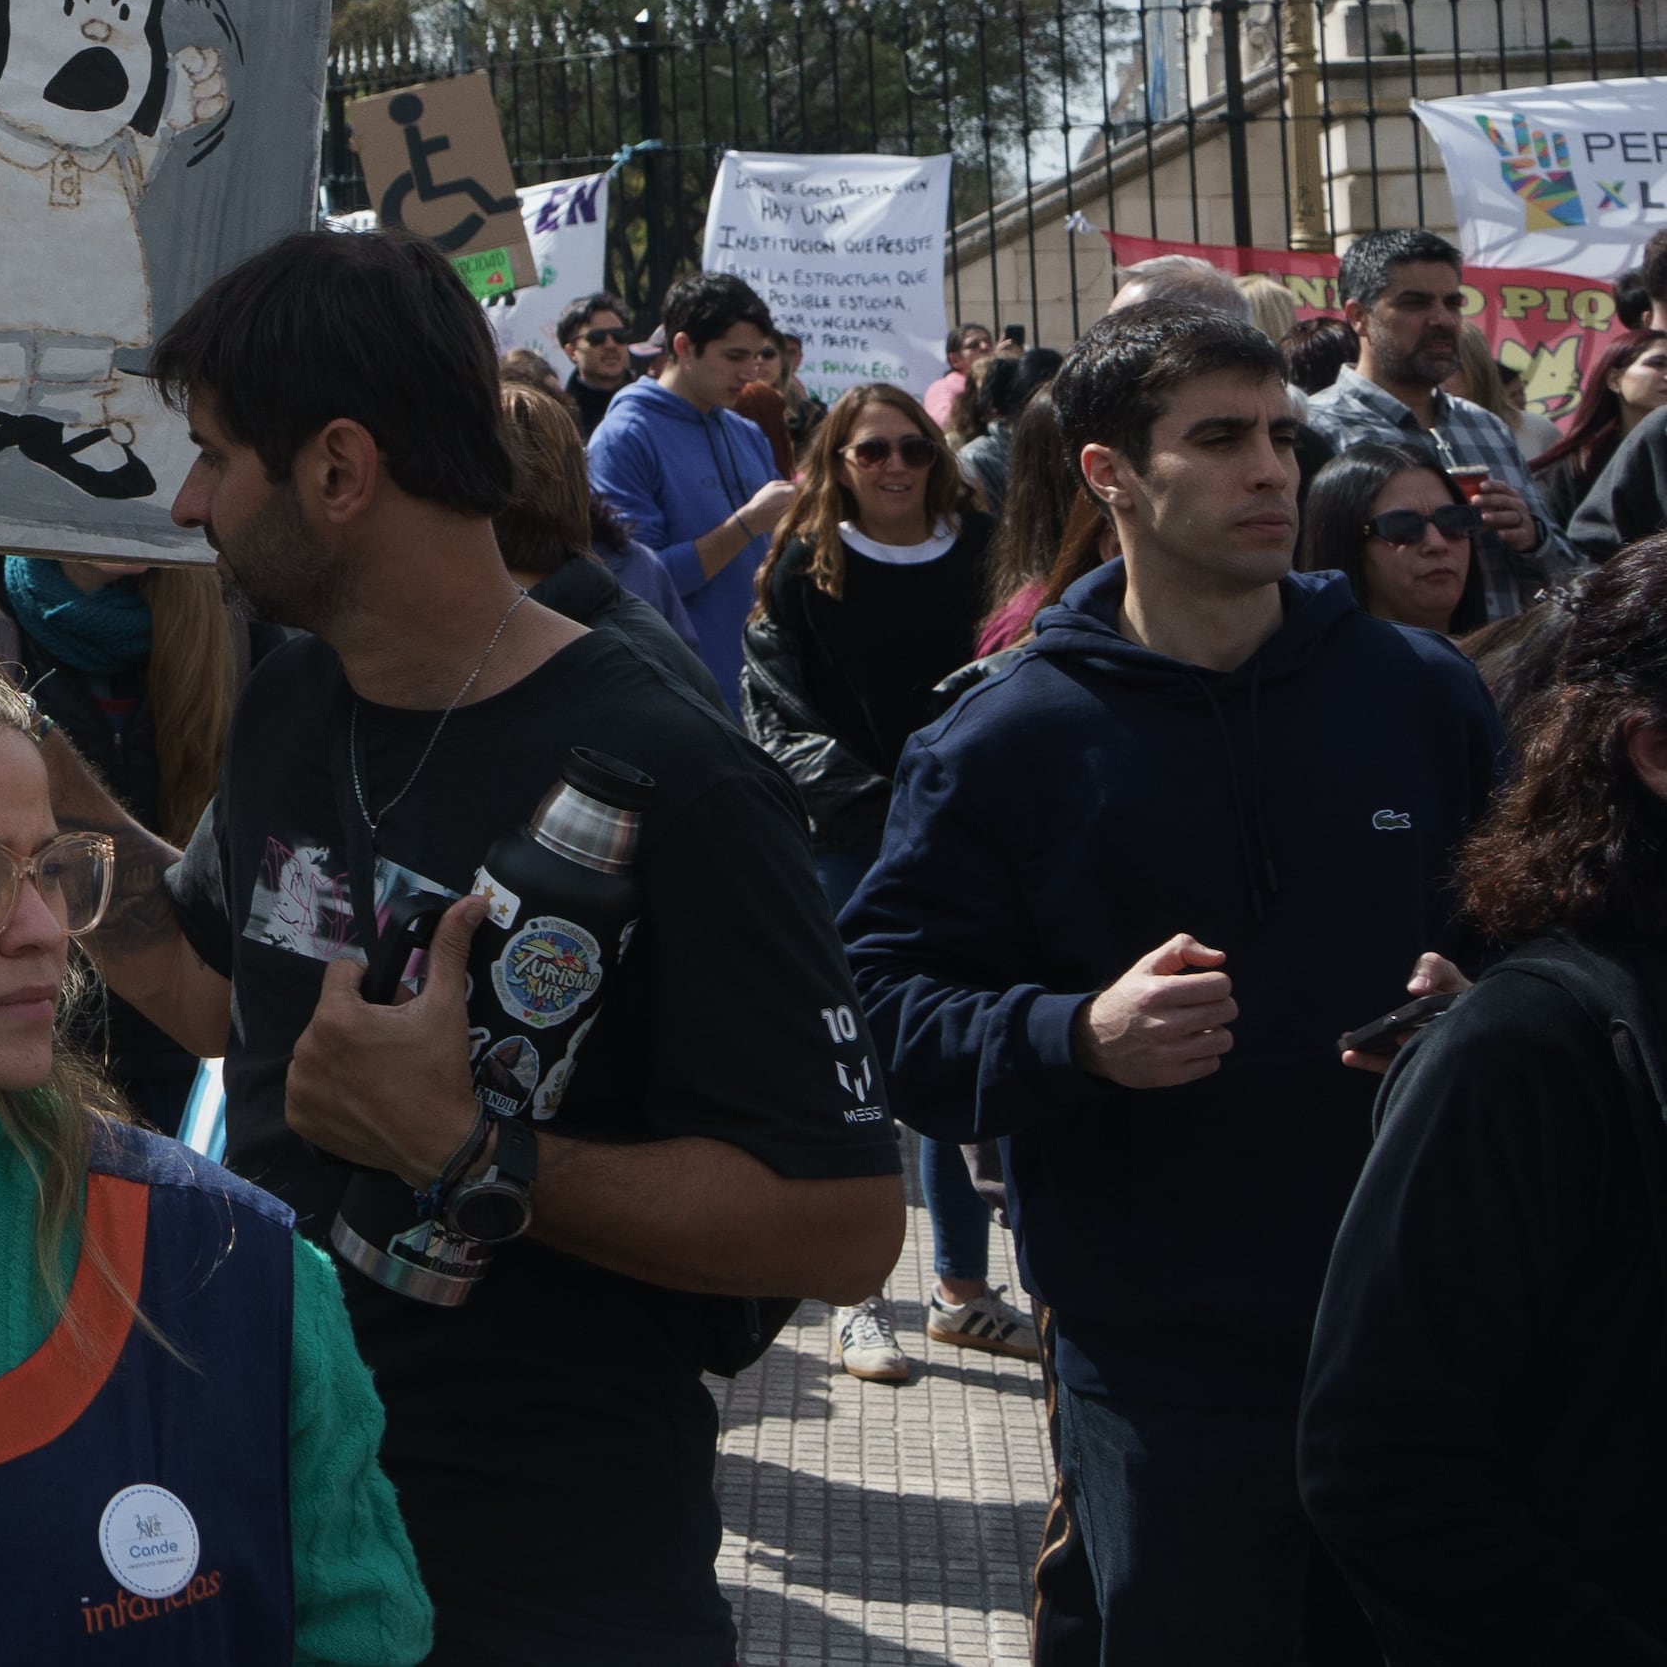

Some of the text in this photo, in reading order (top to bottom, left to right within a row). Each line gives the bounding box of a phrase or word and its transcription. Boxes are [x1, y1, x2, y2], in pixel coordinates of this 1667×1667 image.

[760, 198, 848, 226] HAY UNA
[718, 225, 836, 254] INSTITUCION
[876, 234, 934, 255] RESISTE
[768, 270, 789, 285] LA
[793, 268, 890, 287] ESTRUCTURA
[896, 267, 929, 286] QUE
[768, 287, 832, 310] POSIBLE
[822, 332, 871, 352] PARTE
[820, 1004, 858, 1044] 10
[129, 1539, 179, 1559] Cande
